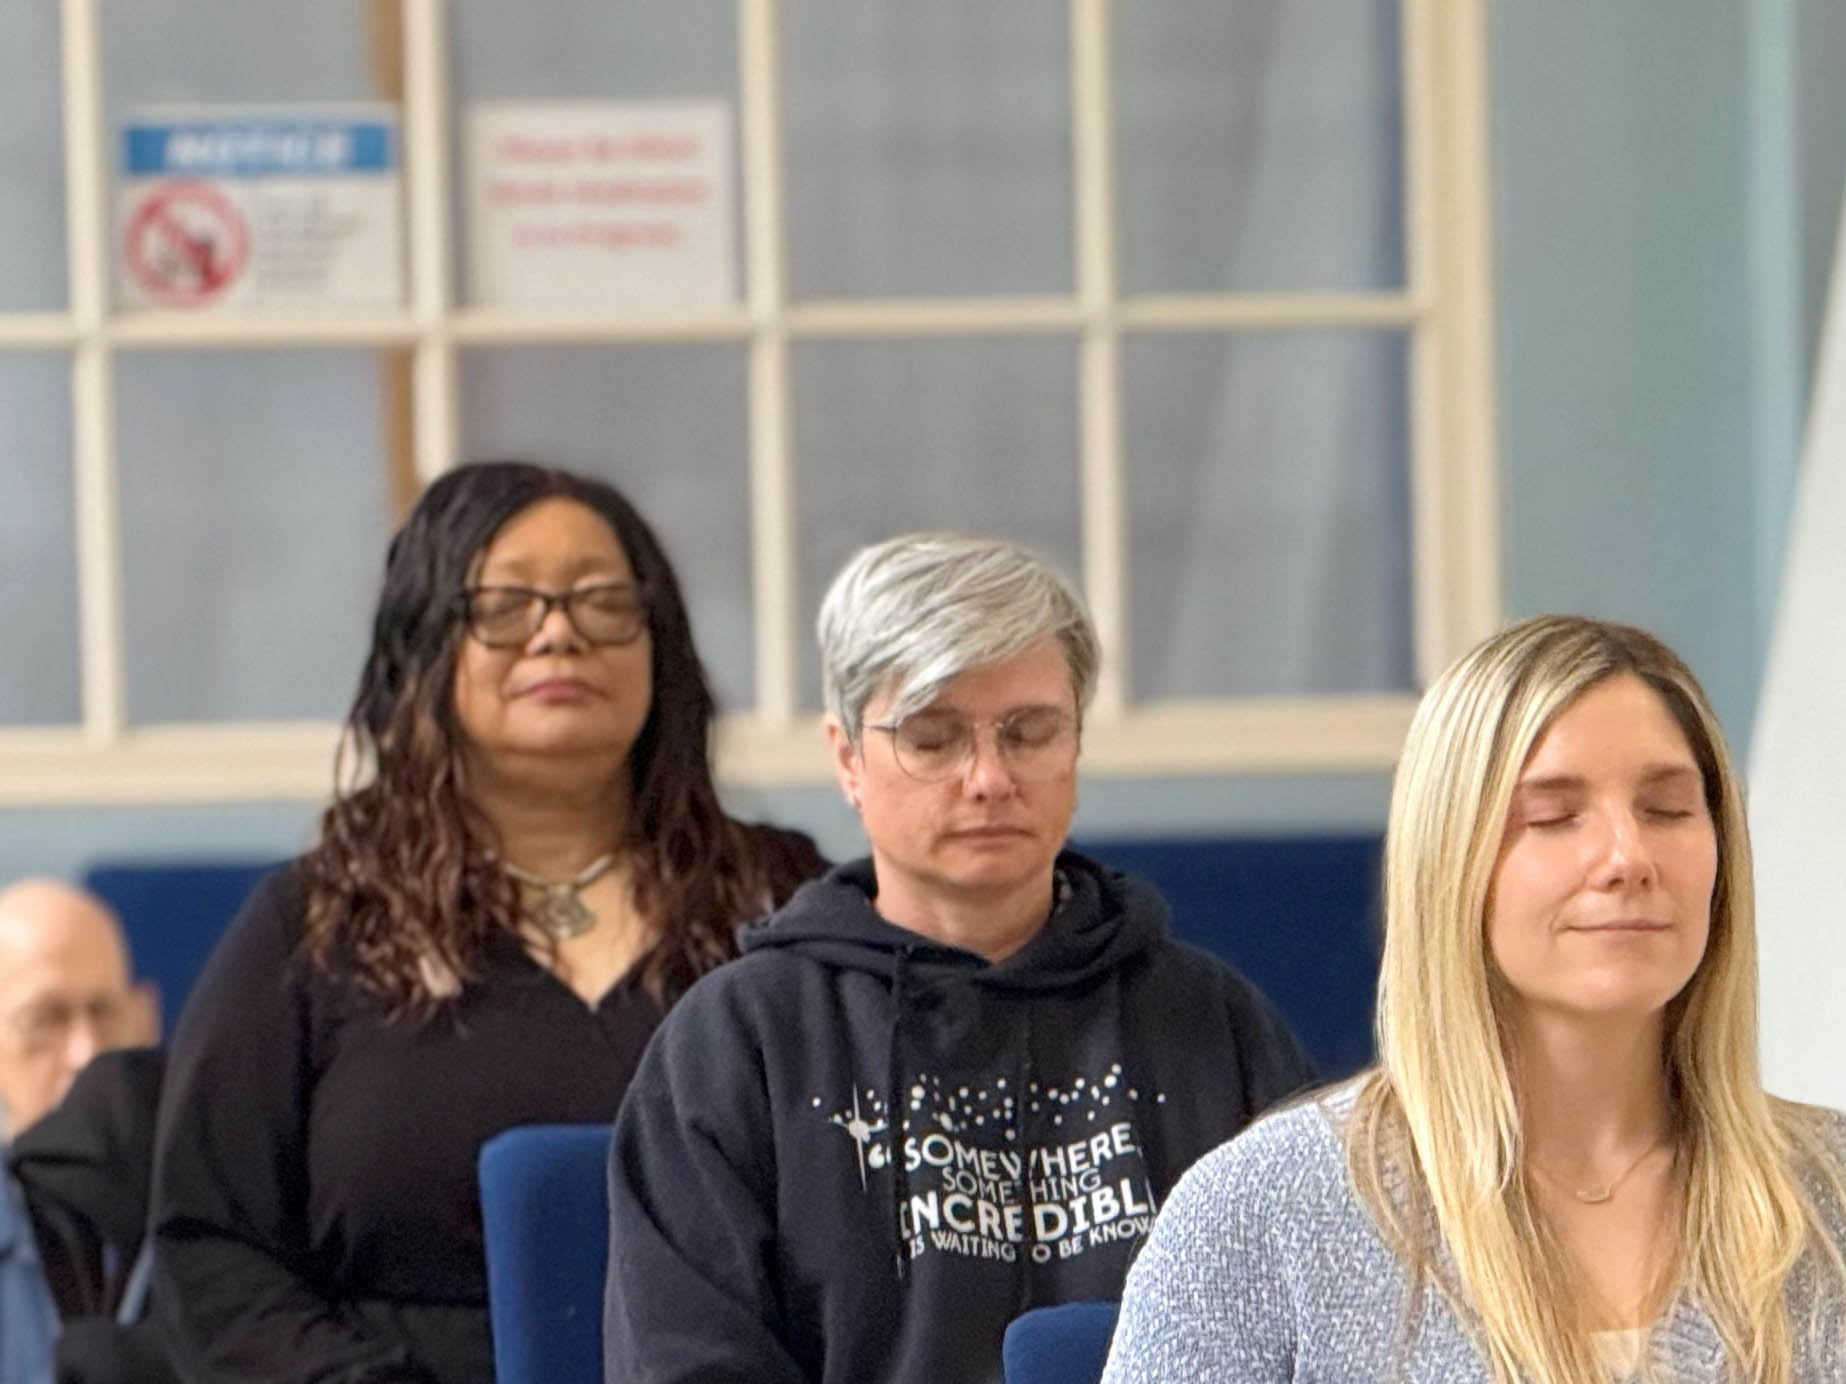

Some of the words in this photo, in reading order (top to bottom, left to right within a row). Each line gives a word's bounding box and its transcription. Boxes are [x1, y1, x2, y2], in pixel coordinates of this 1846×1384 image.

[942, 1166, 1101, 1206] SOMEHING
[930, 1230, 1017, 1262] WAITING
[1059, 1234, 1083, 1259] BE
[1089, 1216, 1156, 1247] KNOW
